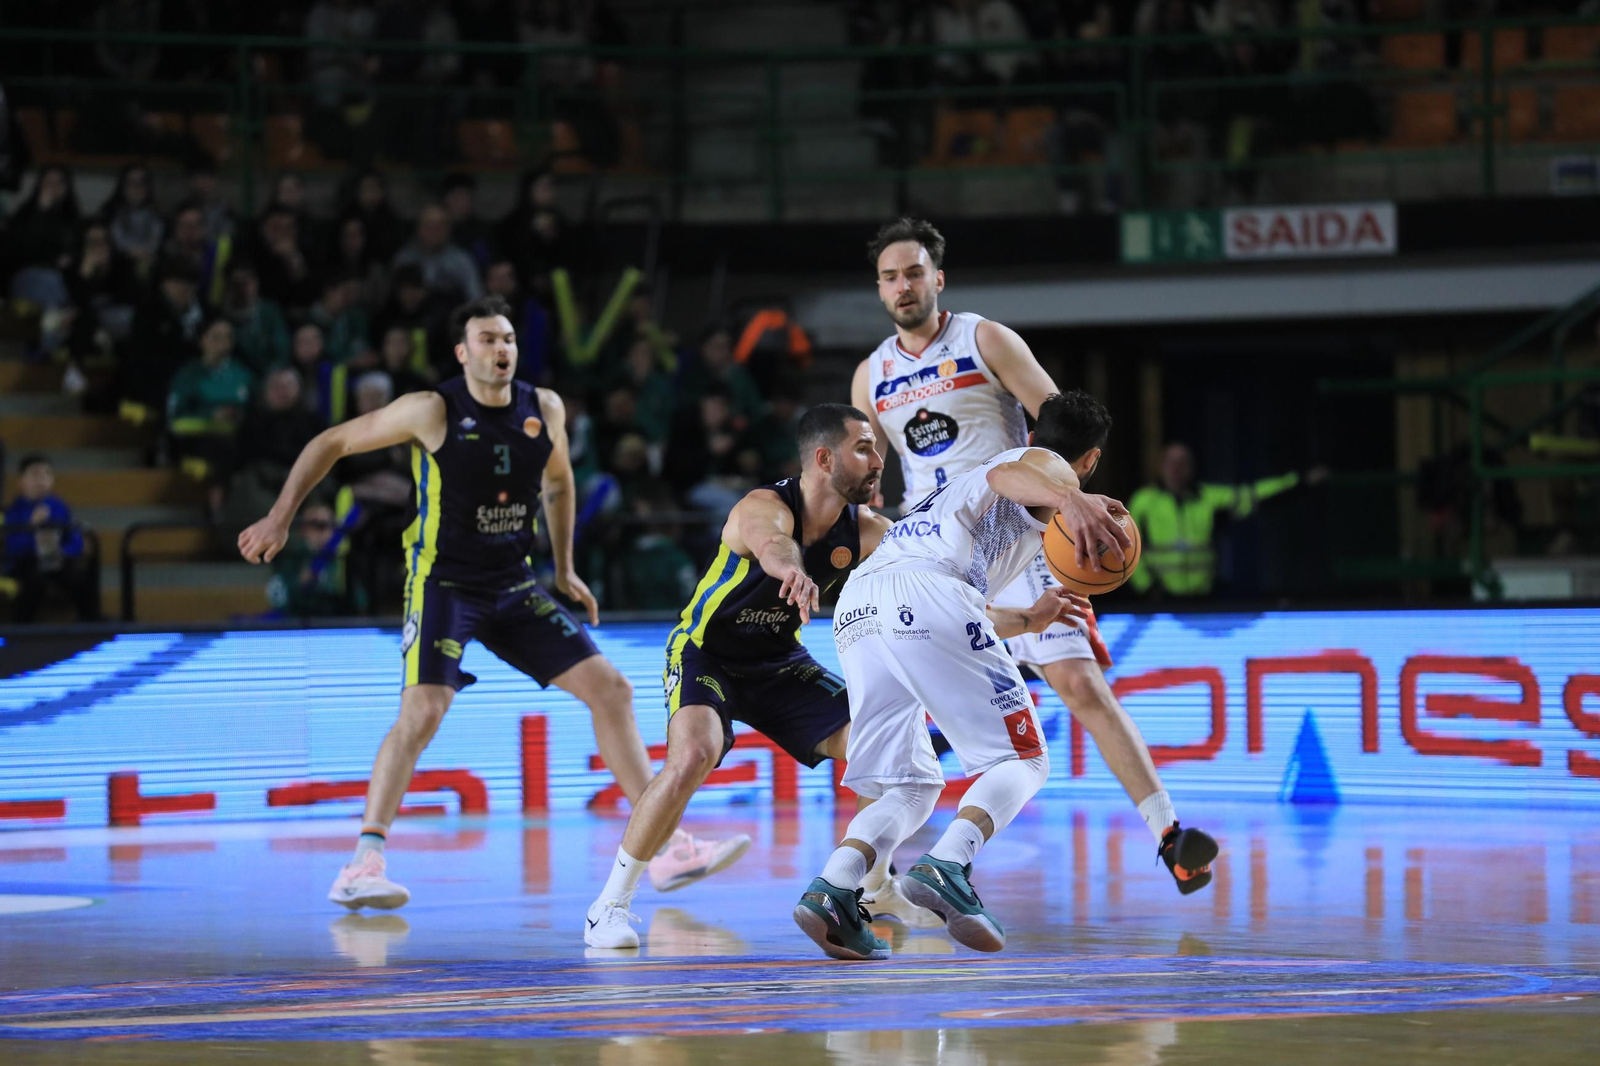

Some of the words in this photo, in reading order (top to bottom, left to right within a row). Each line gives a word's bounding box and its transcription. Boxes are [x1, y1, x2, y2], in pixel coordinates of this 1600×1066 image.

[1232, 210, 1386, 251] SAIDA
[883, 379, 955, 410] OBRADOIRO
[494, 444, 512, 475] 3
[549, 612, 579, 638] 3
[893, 628, 930, 636] Deputación
[966, 621, 996, 652] 21
